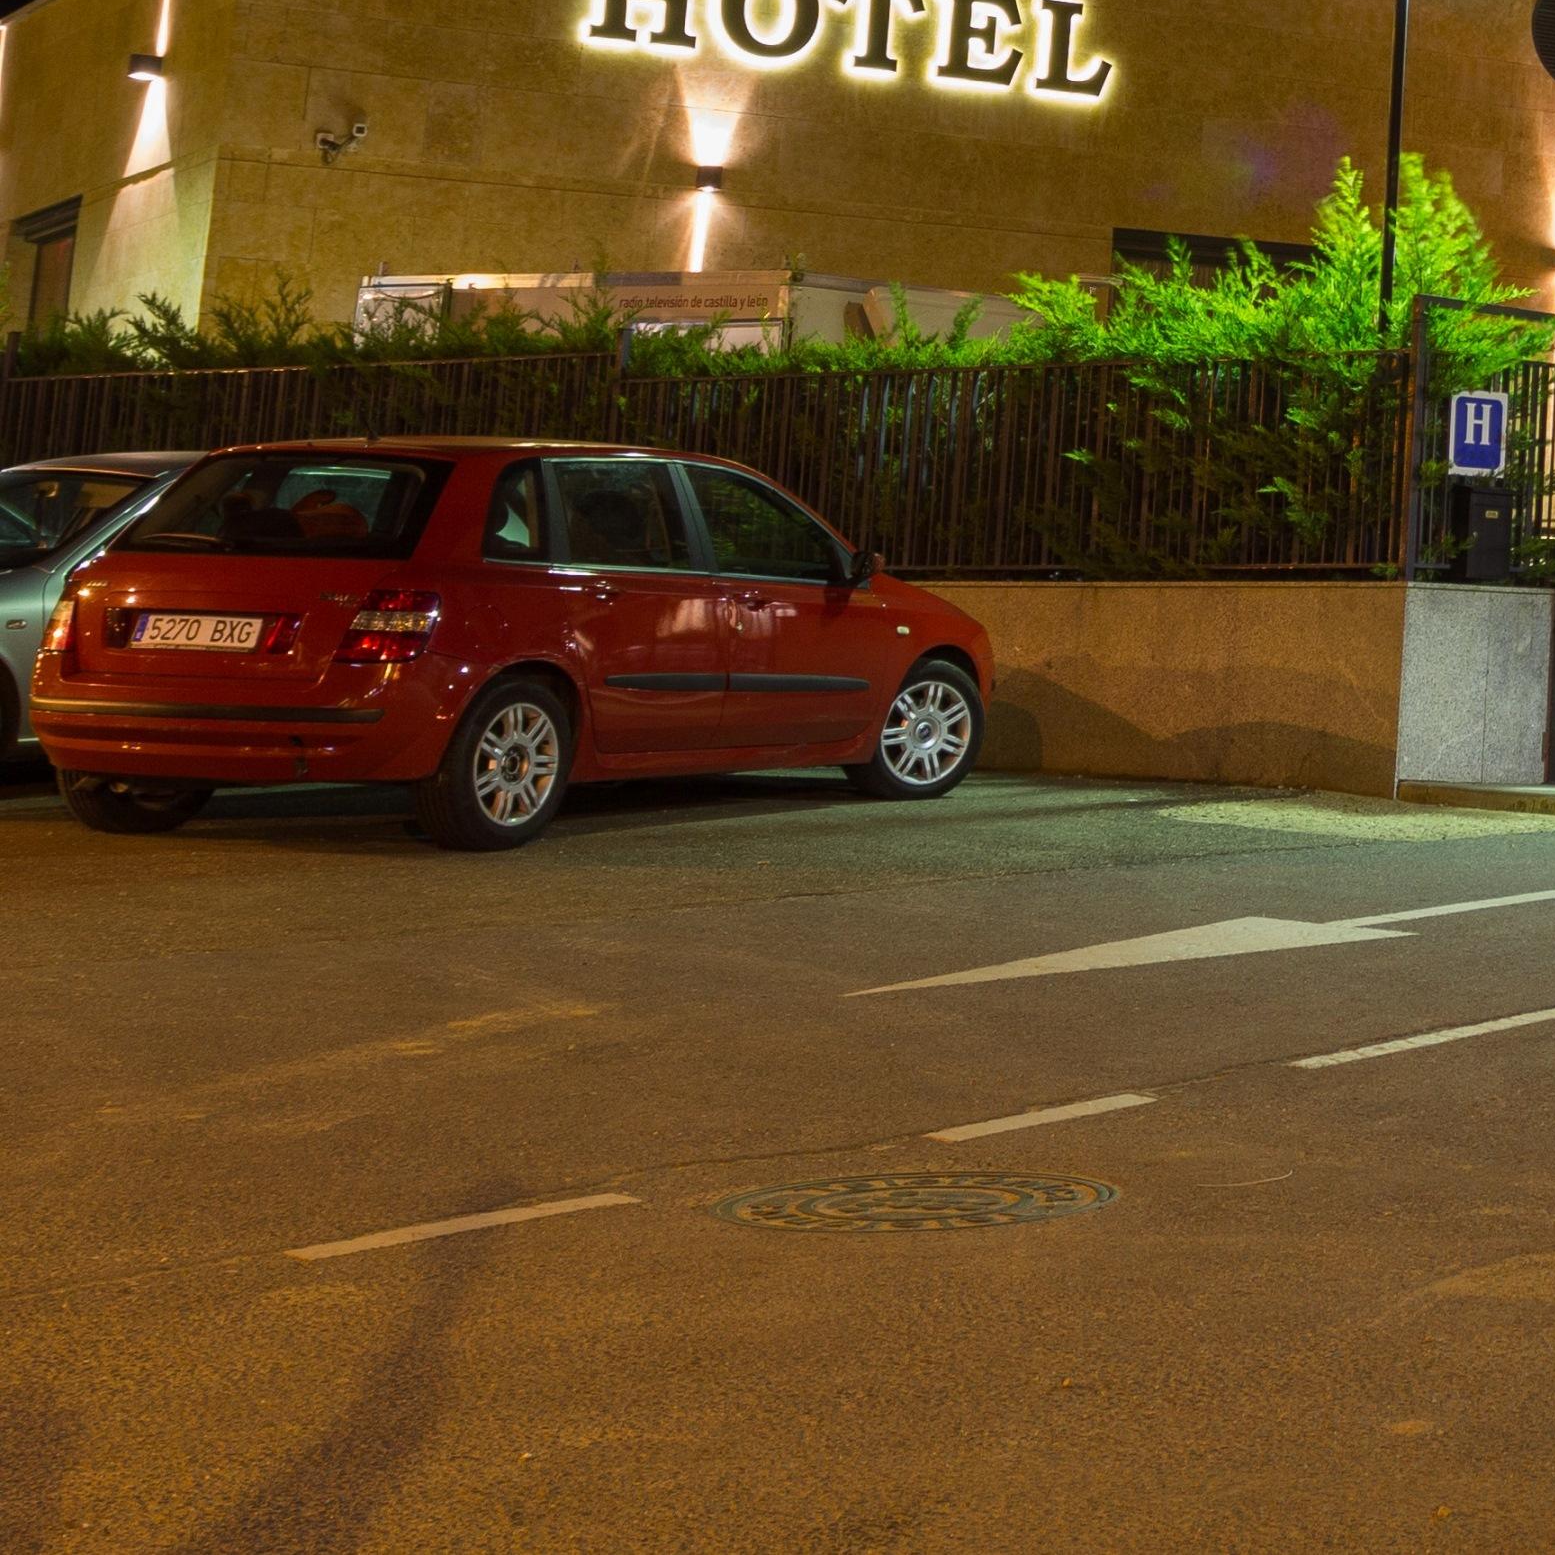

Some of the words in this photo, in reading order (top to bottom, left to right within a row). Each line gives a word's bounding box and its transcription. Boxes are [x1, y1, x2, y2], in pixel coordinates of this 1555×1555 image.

[619, 295, 643, 308] radio
[690, 296, 702, 308] de
[704, 295, 738, 308] castilla
[739, 298, 746, 311] y
[1463, 402, 1492, 446] H
[148, 617, 201, 641] 5270
[209, 619, 254, 644] BXG
